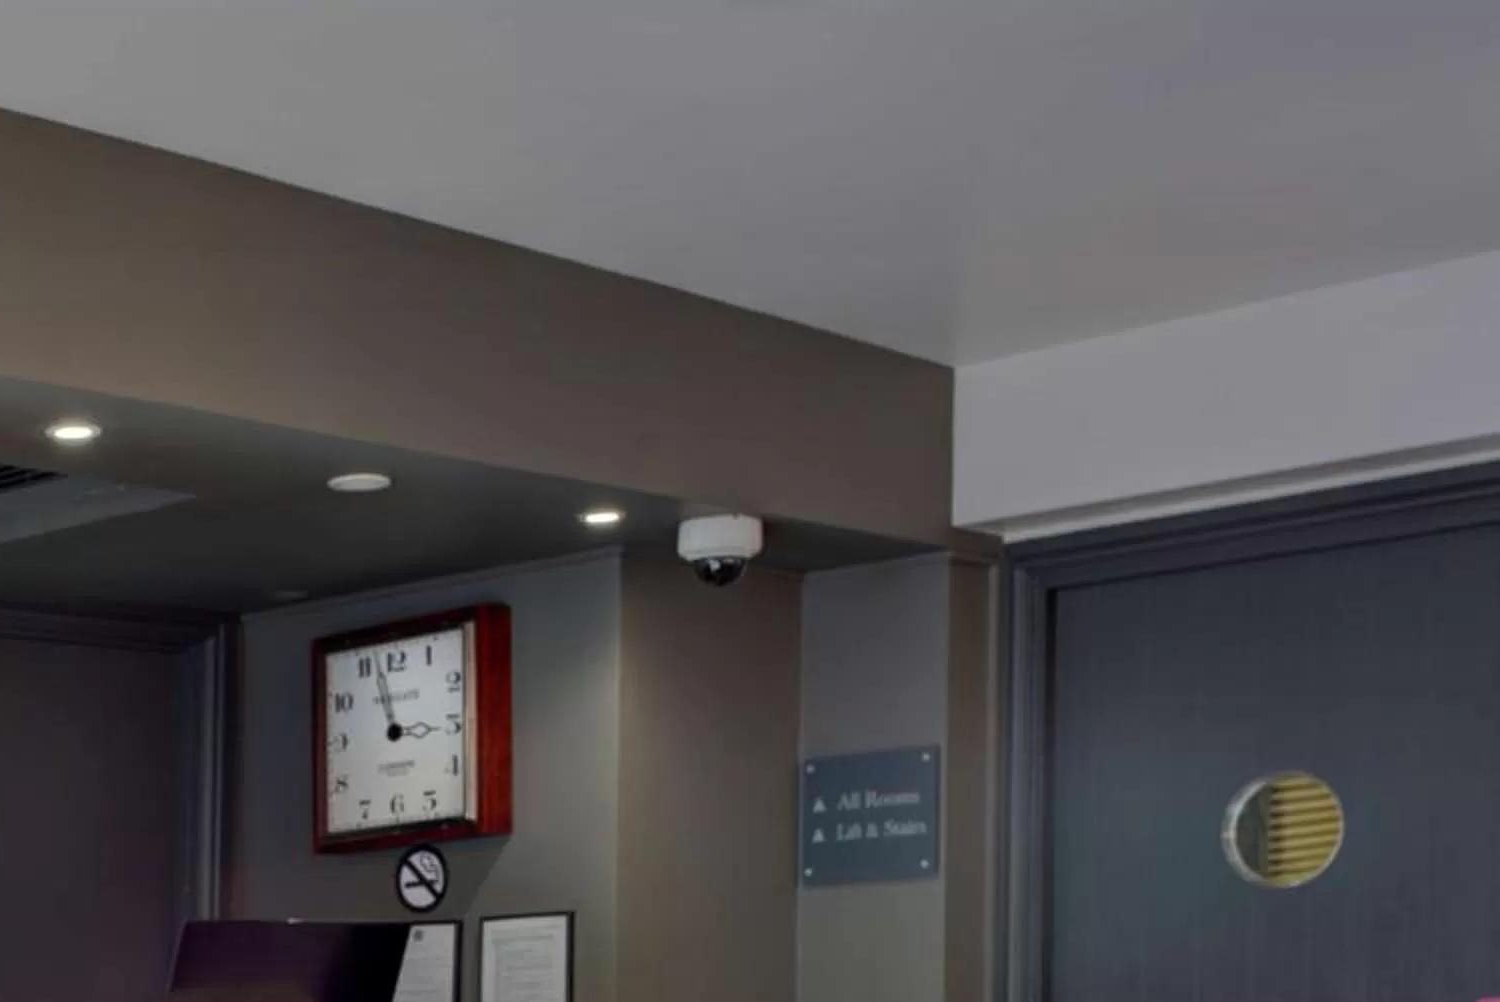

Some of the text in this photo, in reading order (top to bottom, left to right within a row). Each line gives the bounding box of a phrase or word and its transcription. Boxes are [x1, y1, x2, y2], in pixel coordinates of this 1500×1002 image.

[387, 651, 406, 672] 12
[425, 645, 432, 666] 1
[446, 672, 461, 693] 2
[335, 692, 353, 713] 10
[446, 713, 461, 735] 3
[444, 754, 458, 777] 4
[335, 775, 348, 794] 8
[359, 800, 371, 820] 7
[390, 796, 404, 814] 6
[423, 791, 437, 811] 5
